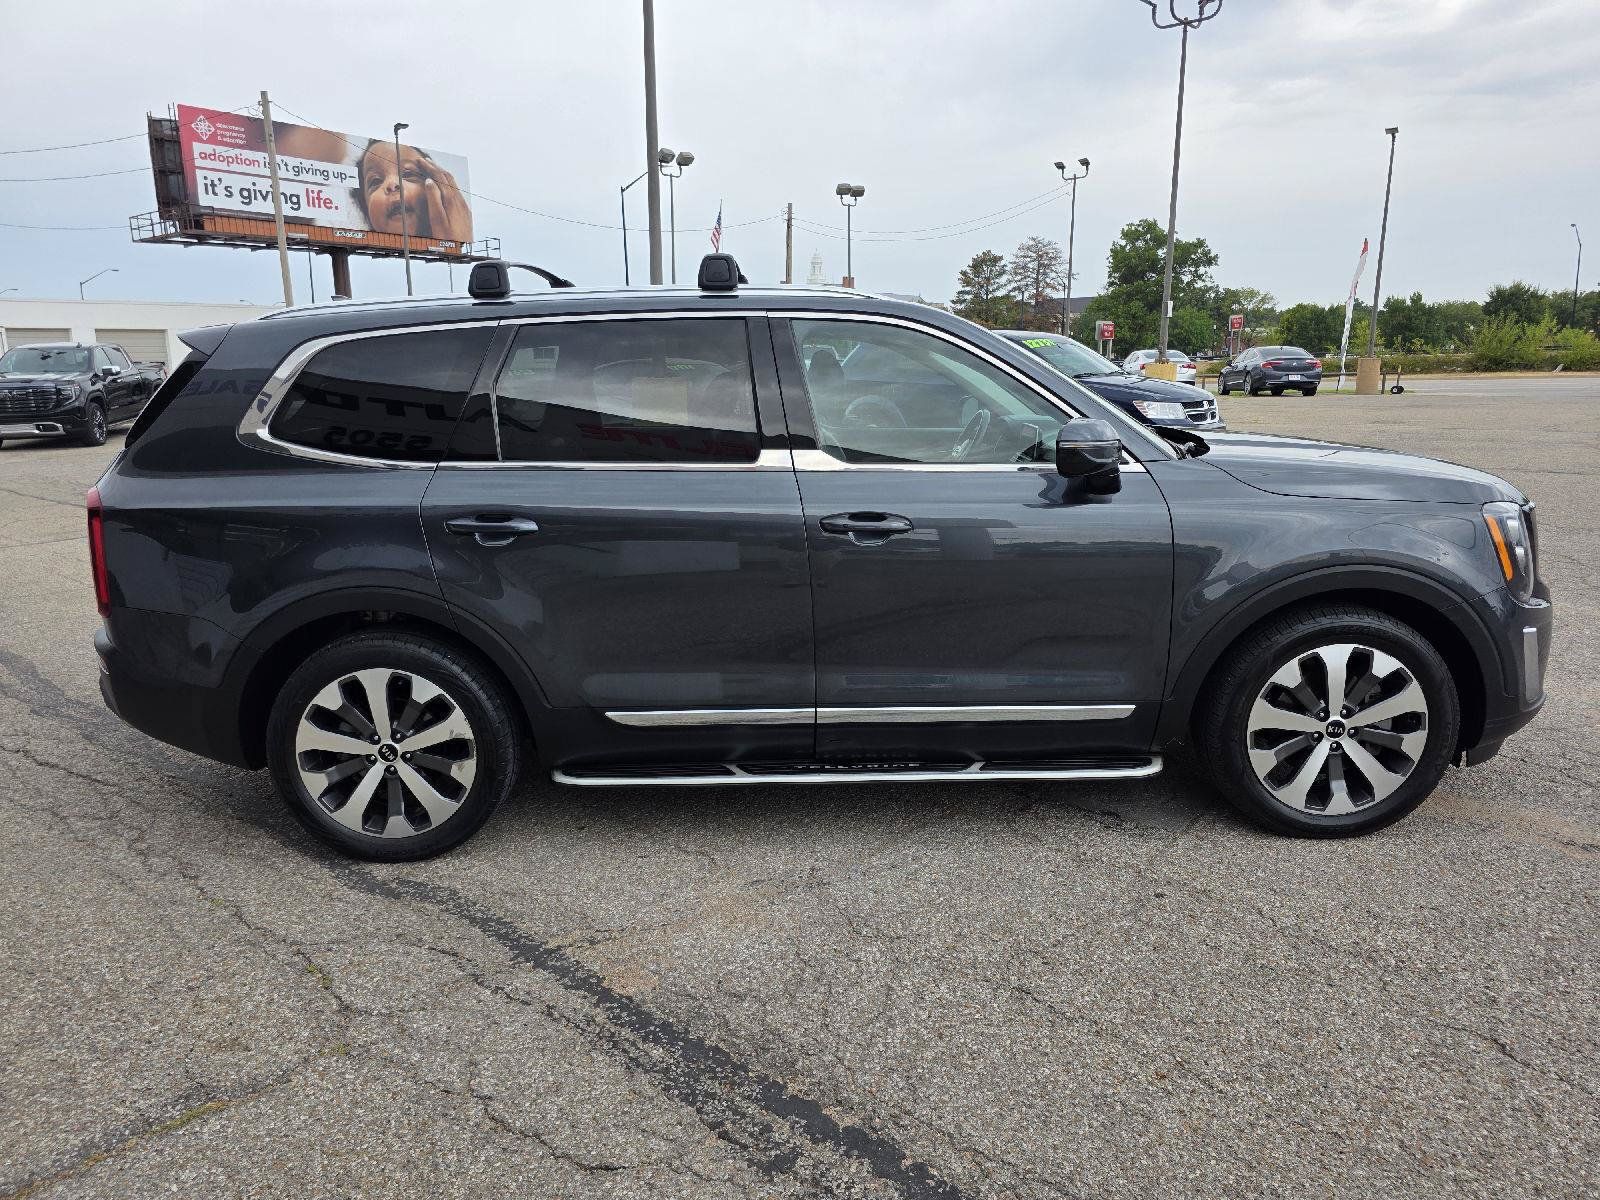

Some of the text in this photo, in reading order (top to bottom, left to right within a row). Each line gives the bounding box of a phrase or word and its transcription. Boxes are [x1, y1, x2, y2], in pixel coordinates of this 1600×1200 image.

[198, 149, 261, 168] adoption
[292, 162, 330, 181] giving
[203, 175, 234, 198] it's
[305, 187, 339, 211] life.
[382, 745, 395, 760] KIA
